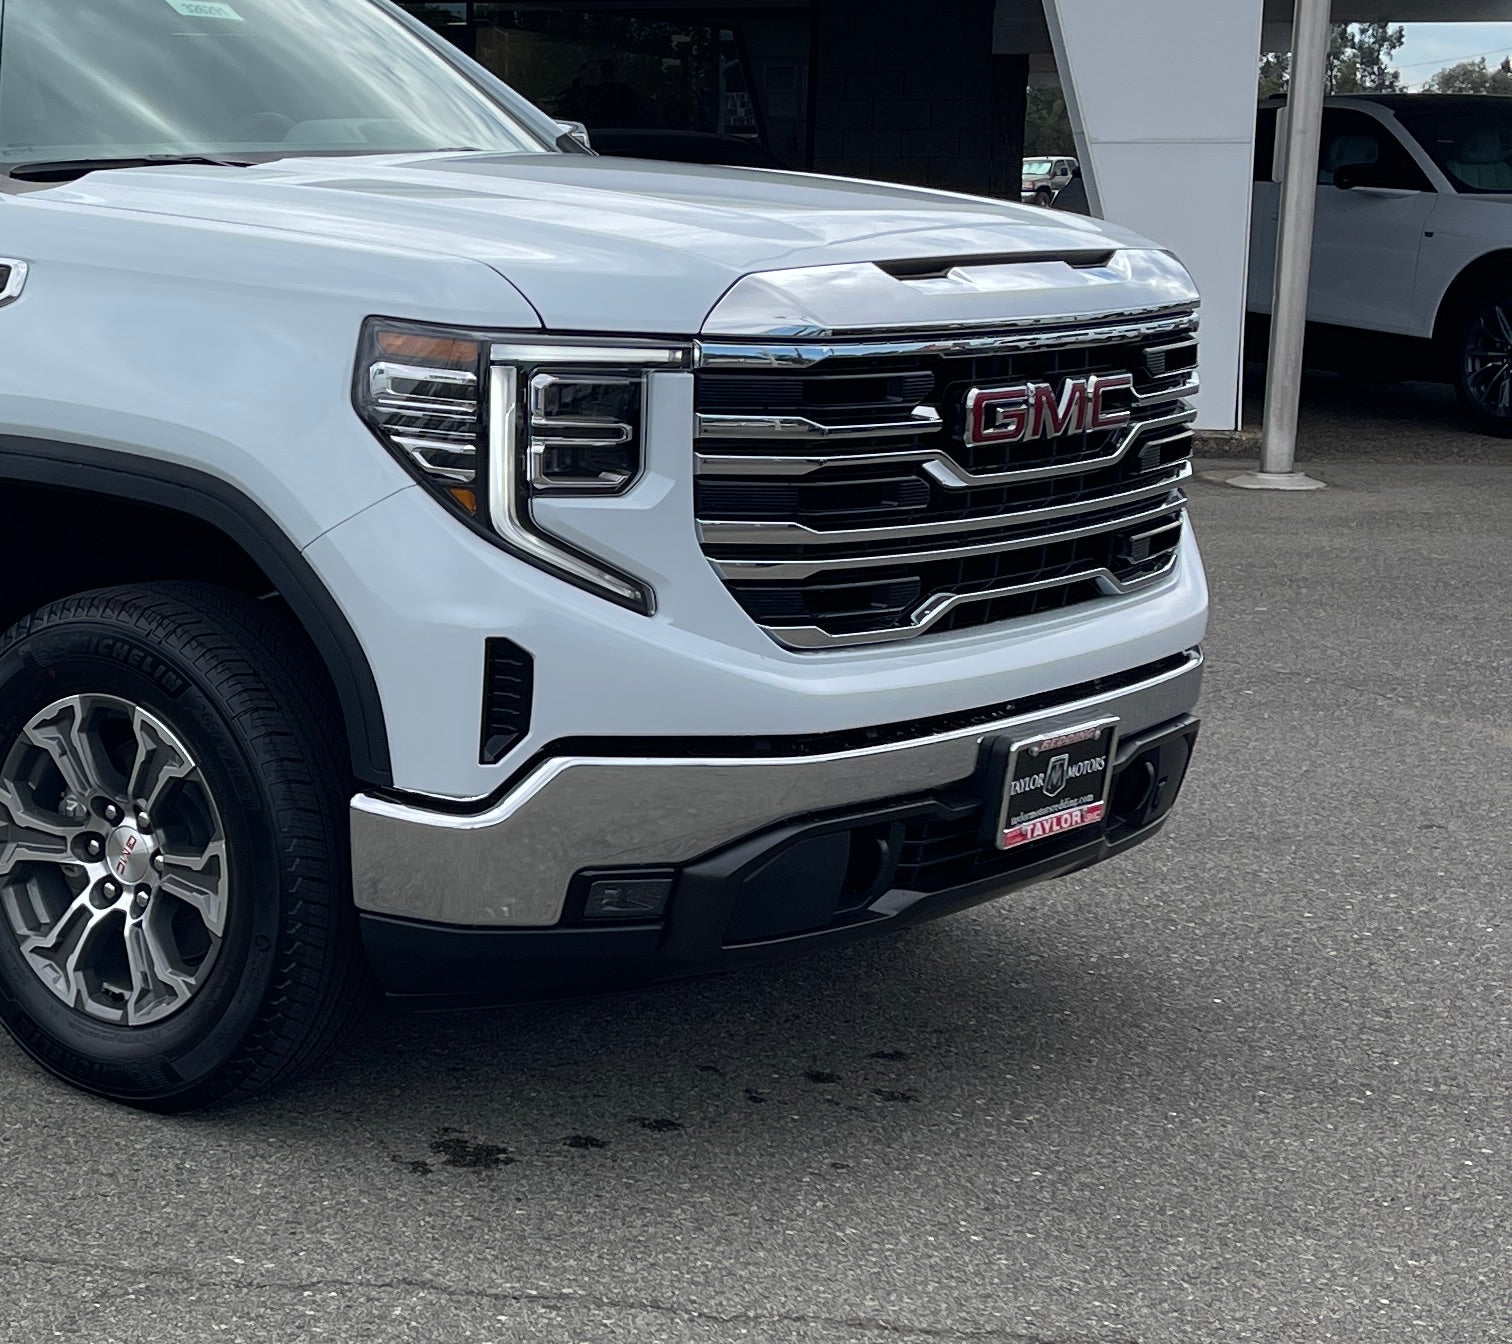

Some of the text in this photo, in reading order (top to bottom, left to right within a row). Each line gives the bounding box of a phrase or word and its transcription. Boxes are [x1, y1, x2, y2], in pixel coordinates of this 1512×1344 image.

[965, 373, 1134, 448] GMC
[1010, 773, 1044, 795] TAYLOR
[1066, 755, 1106, 780] MOTORS
[1025, 810, 1083, 839] TAYLOR
[116, 835, 137, 875] GMC
